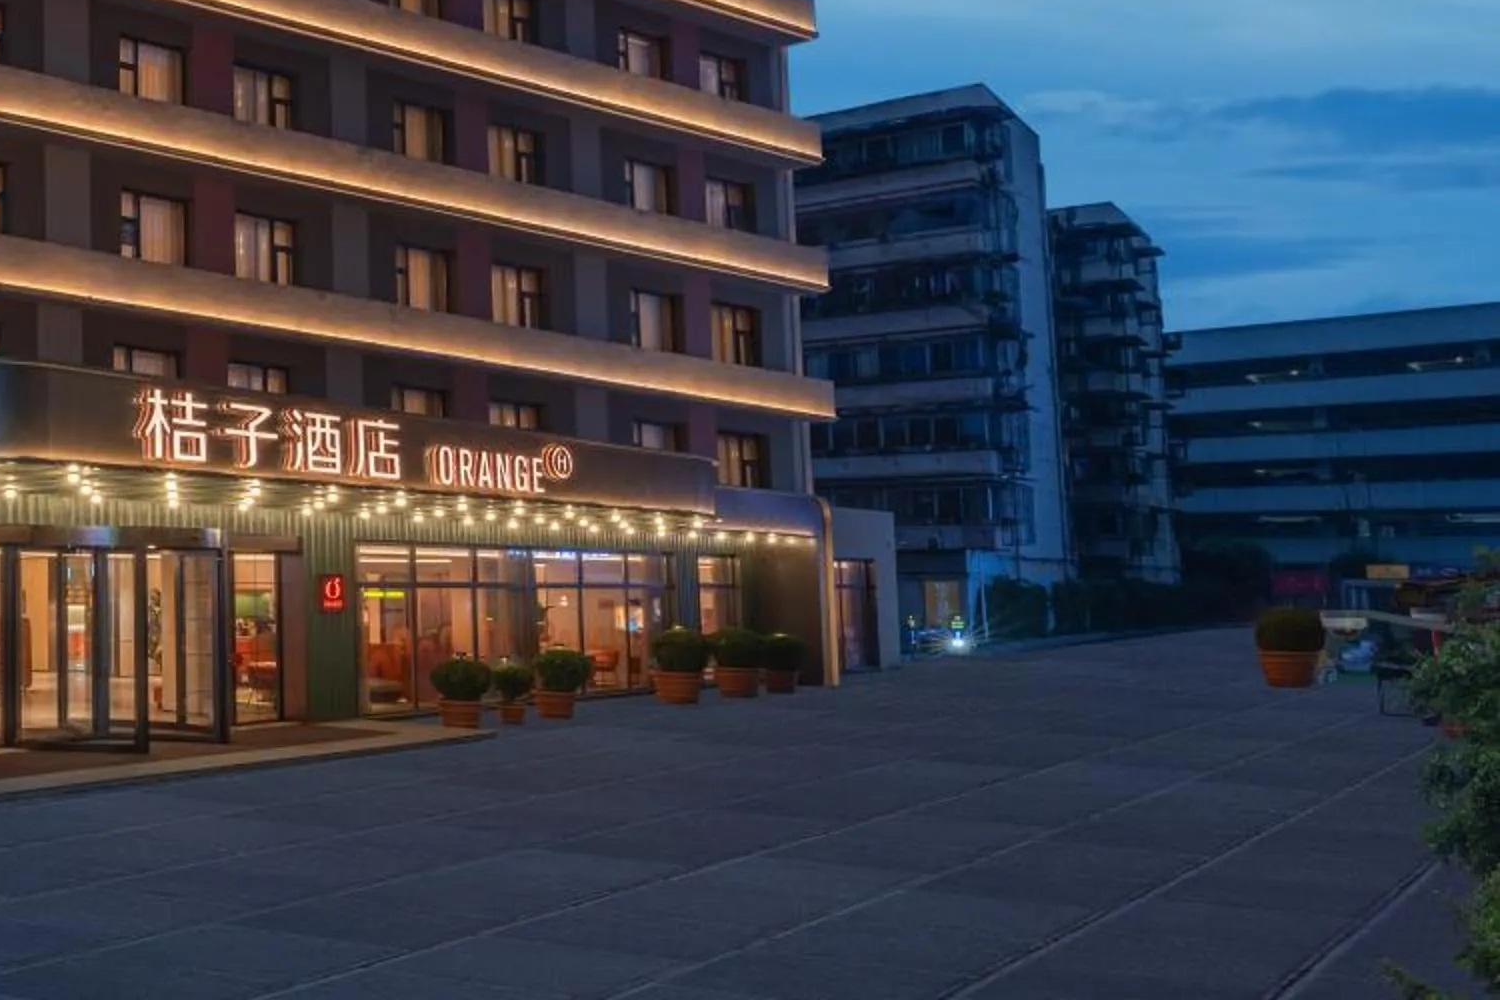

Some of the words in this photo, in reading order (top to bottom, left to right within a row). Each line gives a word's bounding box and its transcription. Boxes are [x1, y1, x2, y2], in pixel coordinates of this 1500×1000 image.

[136, 387, 401, 481] 桔子酒店
[433, 445, 545, 493] ORANGE
